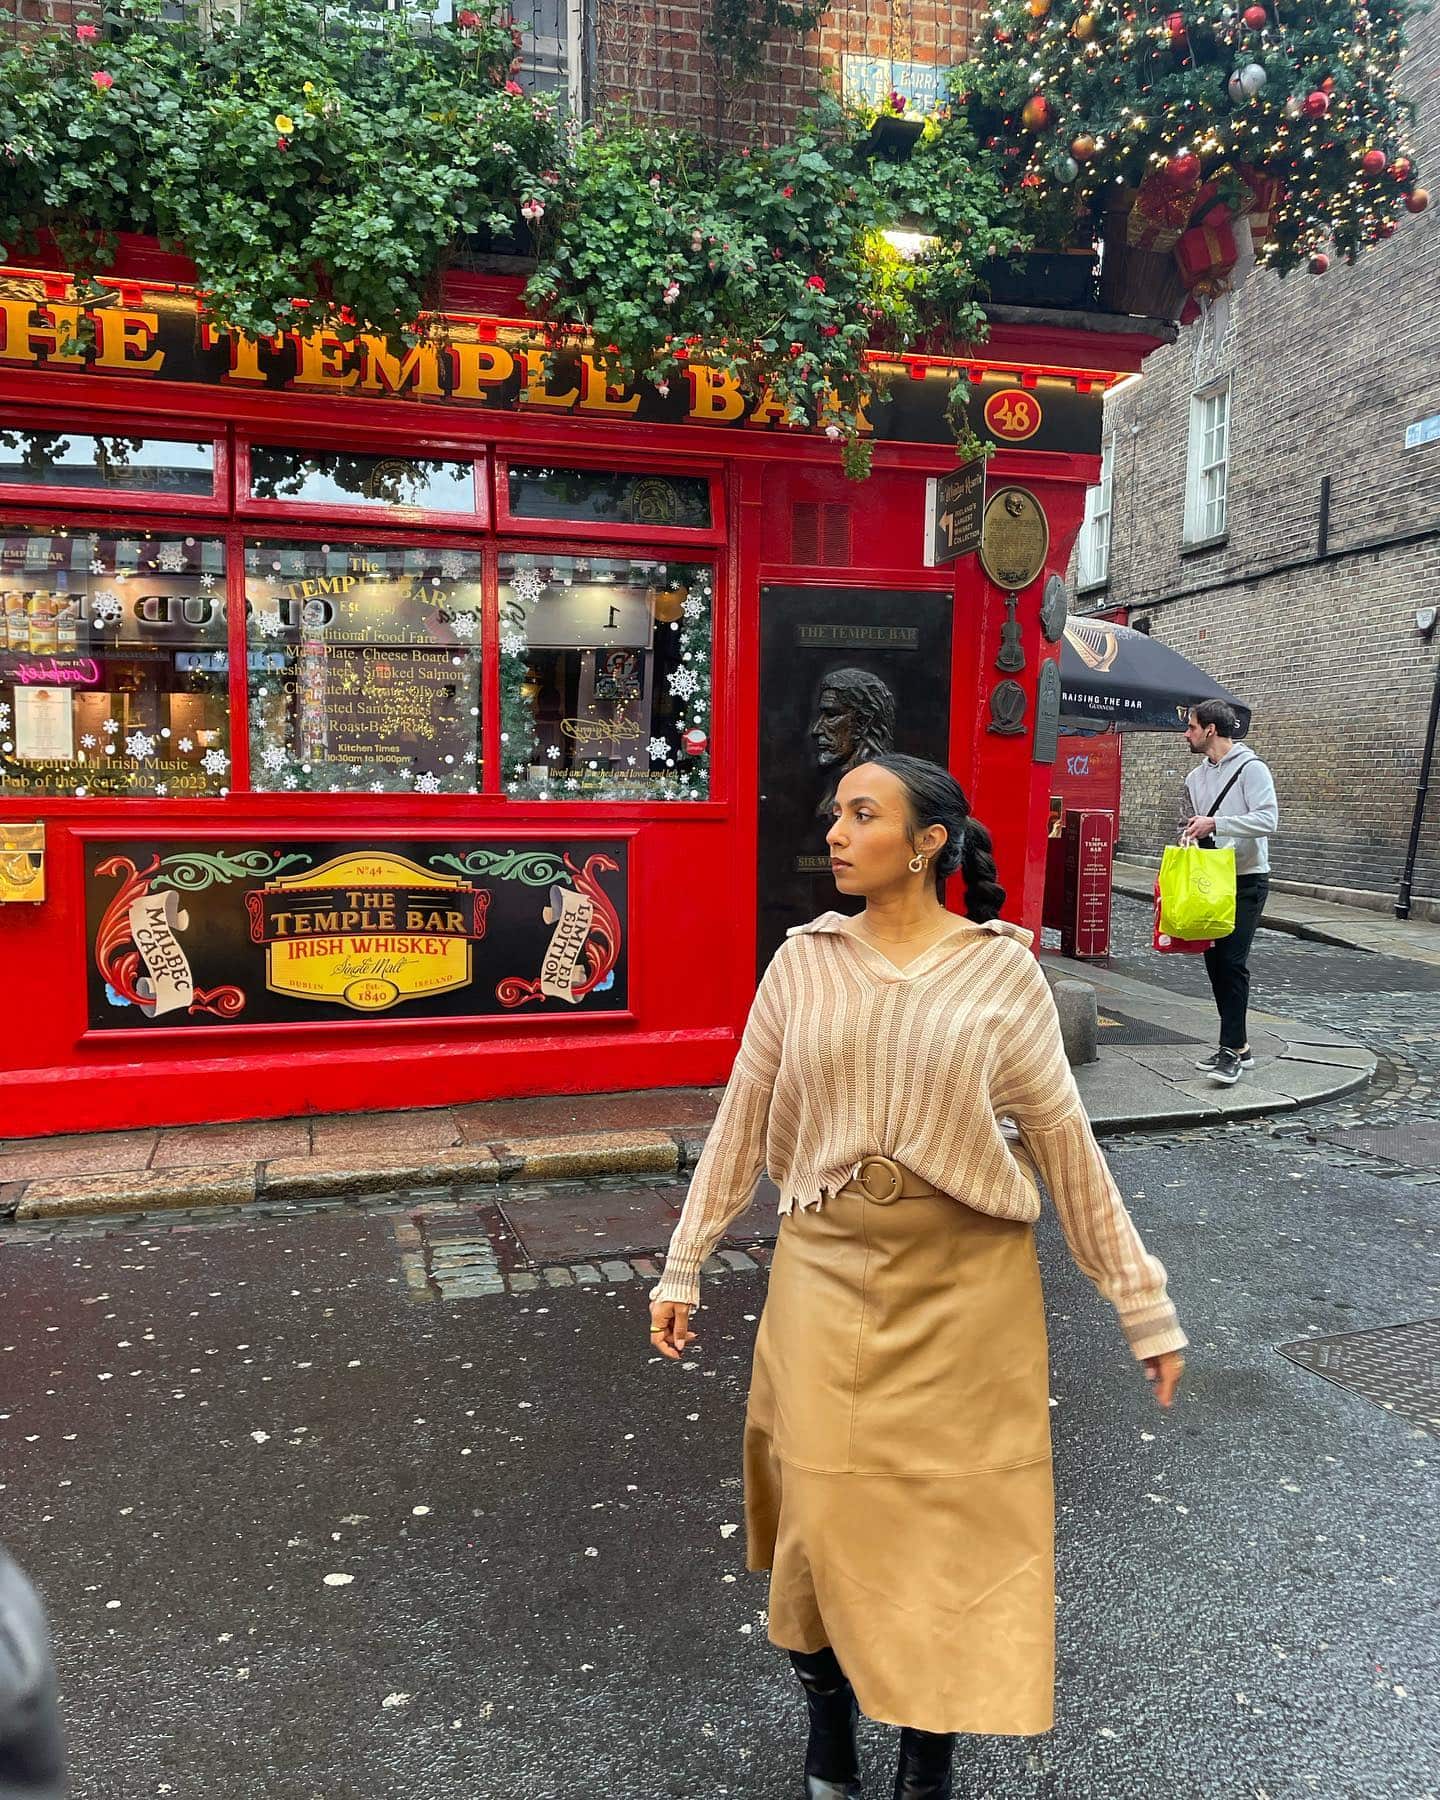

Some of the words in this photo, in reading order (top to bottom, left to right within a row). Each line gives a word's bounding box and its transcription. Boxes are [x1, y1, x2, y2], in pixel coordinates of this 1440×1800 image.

[208, 323, 642, 414] TEMPLE
[993, 398, 1031, 432] 48
[350, 557, 380, 573] The
[302, 628, 369, 641] Tditional
[374, 630, 405, 643] Food
[801, 626, 825, 638] THE
[832, 628, 885, 640] TEMPLE
[363, 649, 408, 661] Cheese
[412, 650, 449, 663] Board
[267, 663, 302, 675] Fresh
[363, 665, 414, 679] Smoked
[418, 667, 464, 680] Salmon
[284, 682, 358, 695] Chuterie
[1062, 692, 1100, 704] RAISING
[1103, 697, 1121, 706] THE
[1124, 699, 1142, 709] BAR
[338, 743, 373, 752] Kitchen
[375, 744, 400, 753] Times
[22, 757, 99, 770] Traditional
[107, 757, 139, 770] Irish
[145, 759, 188, 770] Music
[365, 755, 374, 763] to
[376, 755, 410, 765] 10:00pm
[551, 768, 568, 777] lived
[615, 770, 630, 778] and
[630, 769, 649, 778] loved
[650, 770, 665, 778] and
[1, 775, 30, 788] Pub
[35, 774, 51, 787] of
[55, 774, 77, 787] the
[82, 775, 115, 788] Year
[121, 775, 156, 788] 2002
[172, 775, 207, 789] 2023
[345, 891, 396, 909] THE
[270, 911, 396, 937] TEMPLE
[405, 911, 467, 934] BAR
[146, 907, 190, 992] MALBEC
[287, 938, 345, 960] IRISH
[350, 938, 452, 957] WHISKEY
[543, 911, 577, 984] EDITION
[556, 903, 590, 989] LIMITED
[136, 928, 170, 982] CASK
[330, 956, 372, 979] Single
[288, 979, 324, 991] DUBLIN
[414, 976, 454, 988] IRELAND
[358, 991, 387, 1001] 1840
